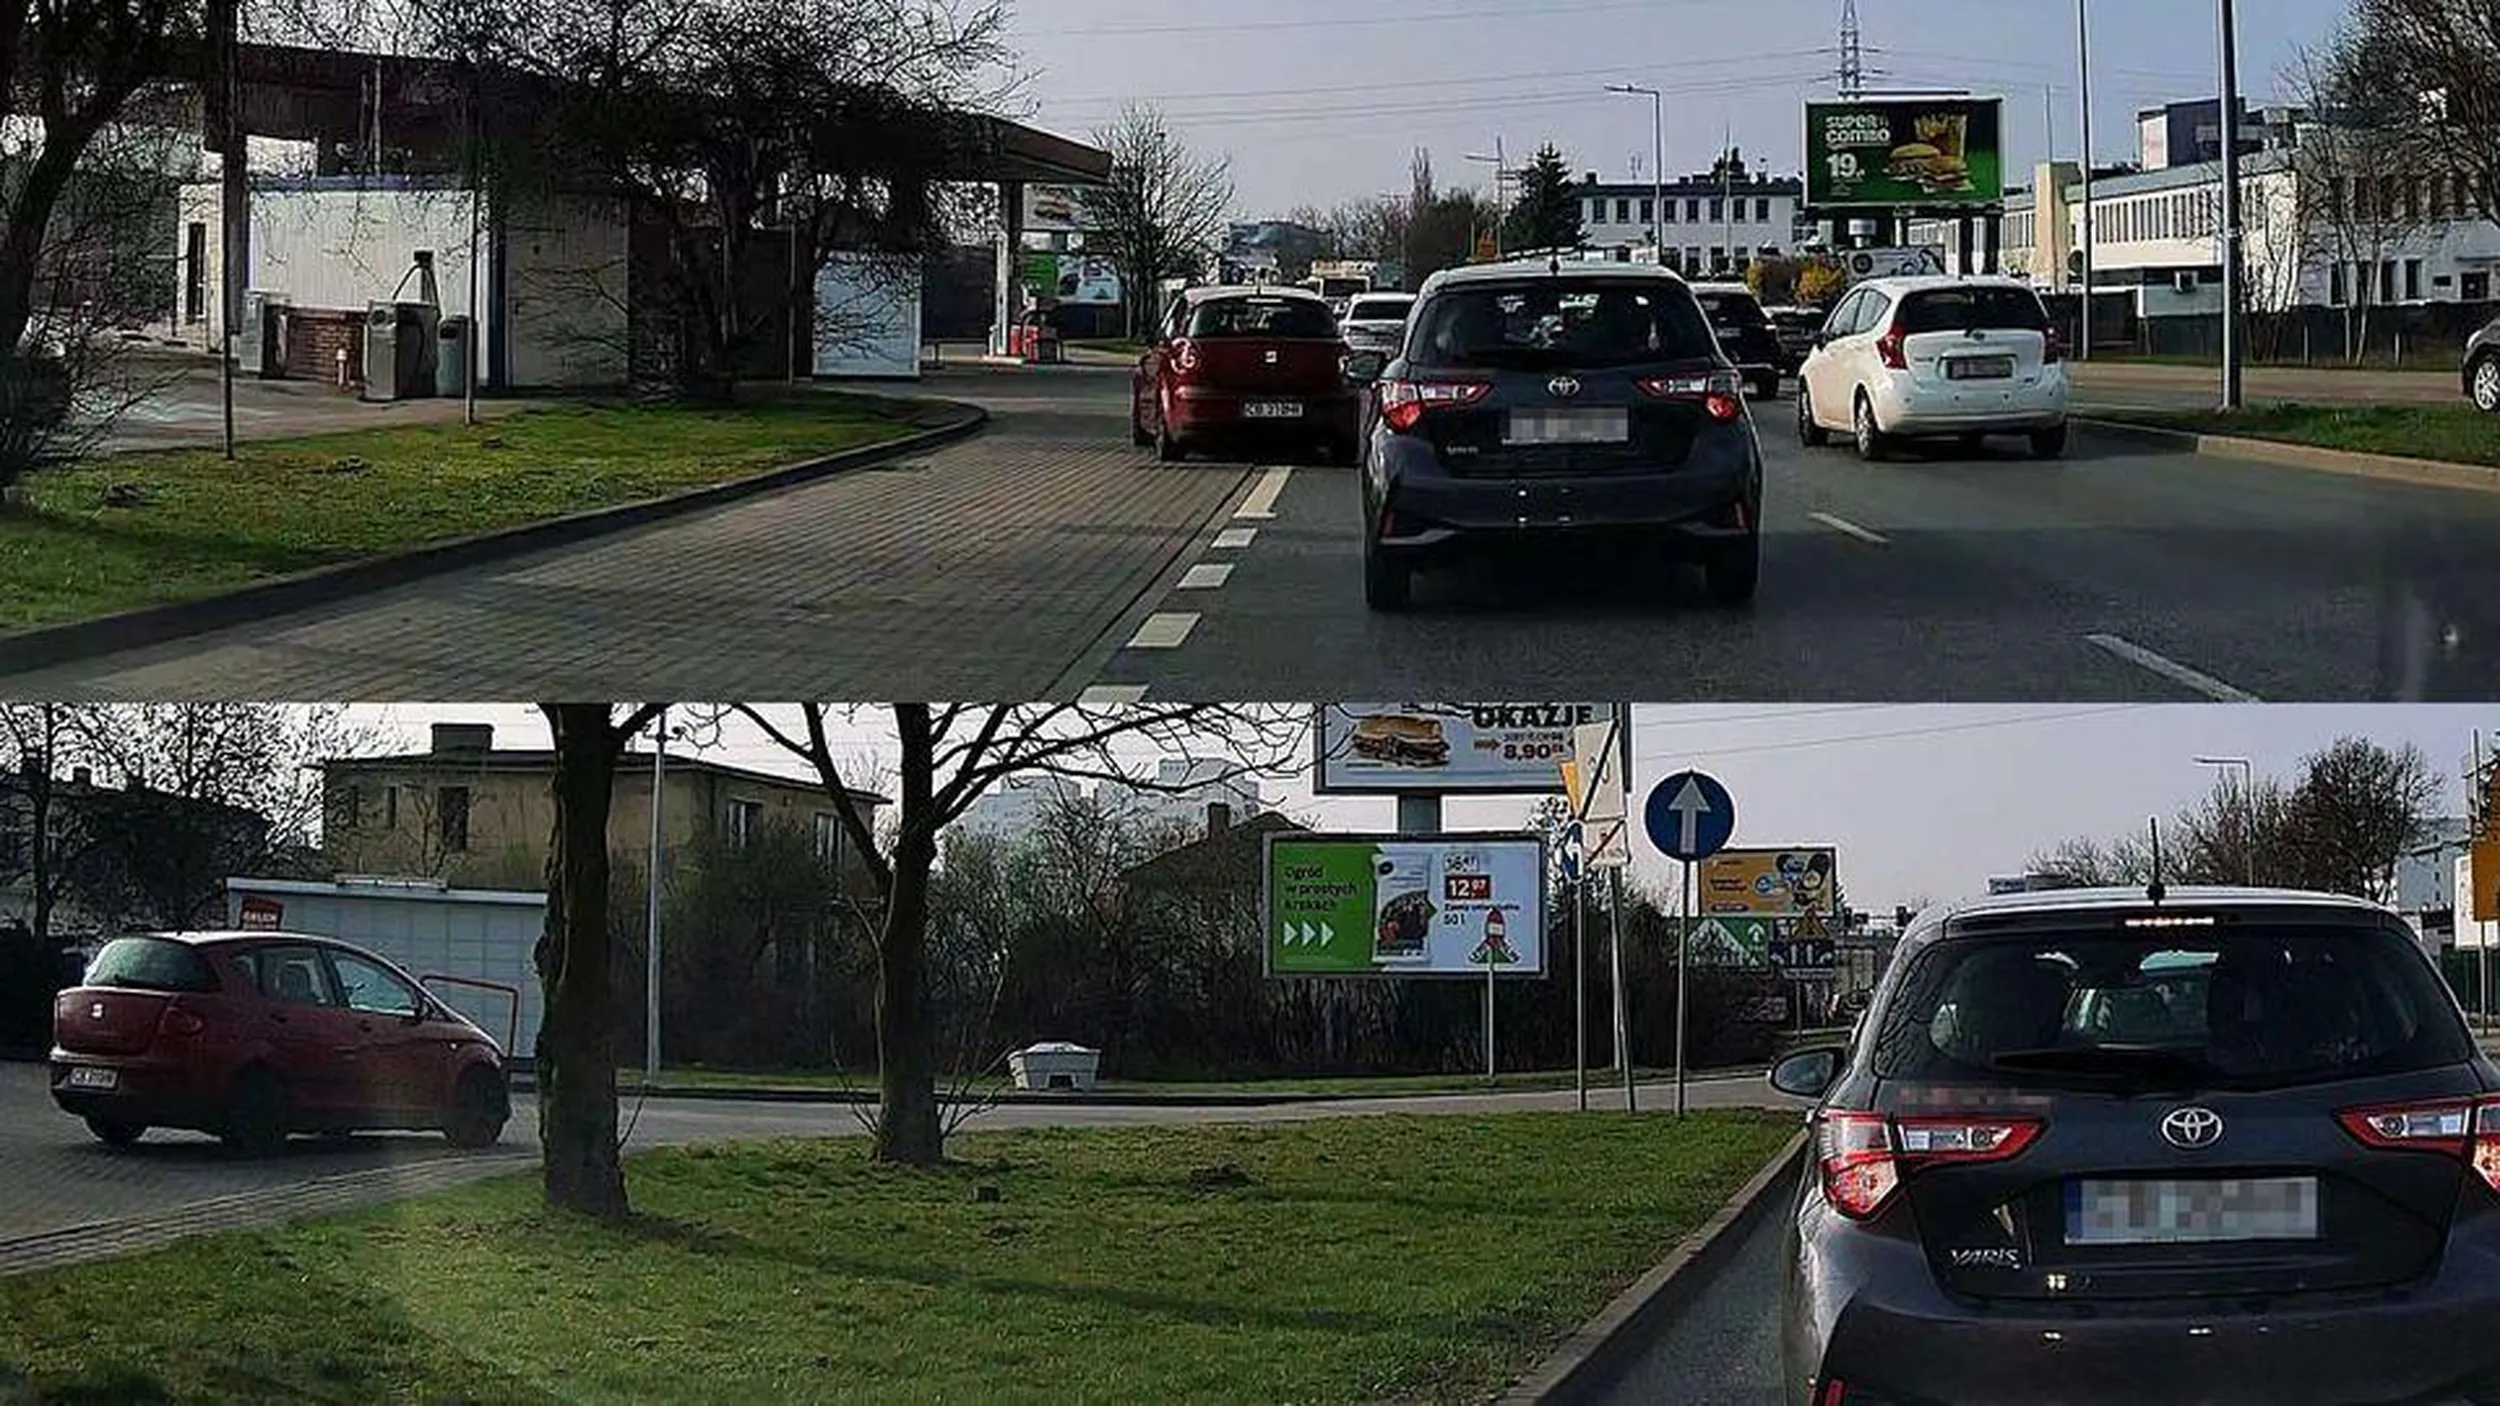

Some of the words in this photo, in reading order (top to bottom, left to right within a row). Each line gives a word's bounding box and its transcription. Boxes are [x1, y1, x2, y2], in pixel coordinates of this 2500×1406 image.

[1825, 114, 1878, 129] SUPER
[1284, 865, 1323, 880] Ogród
[1300, 881, 1357, 897] prostych
[1950, 1248, 2018, 1267] YARIS
